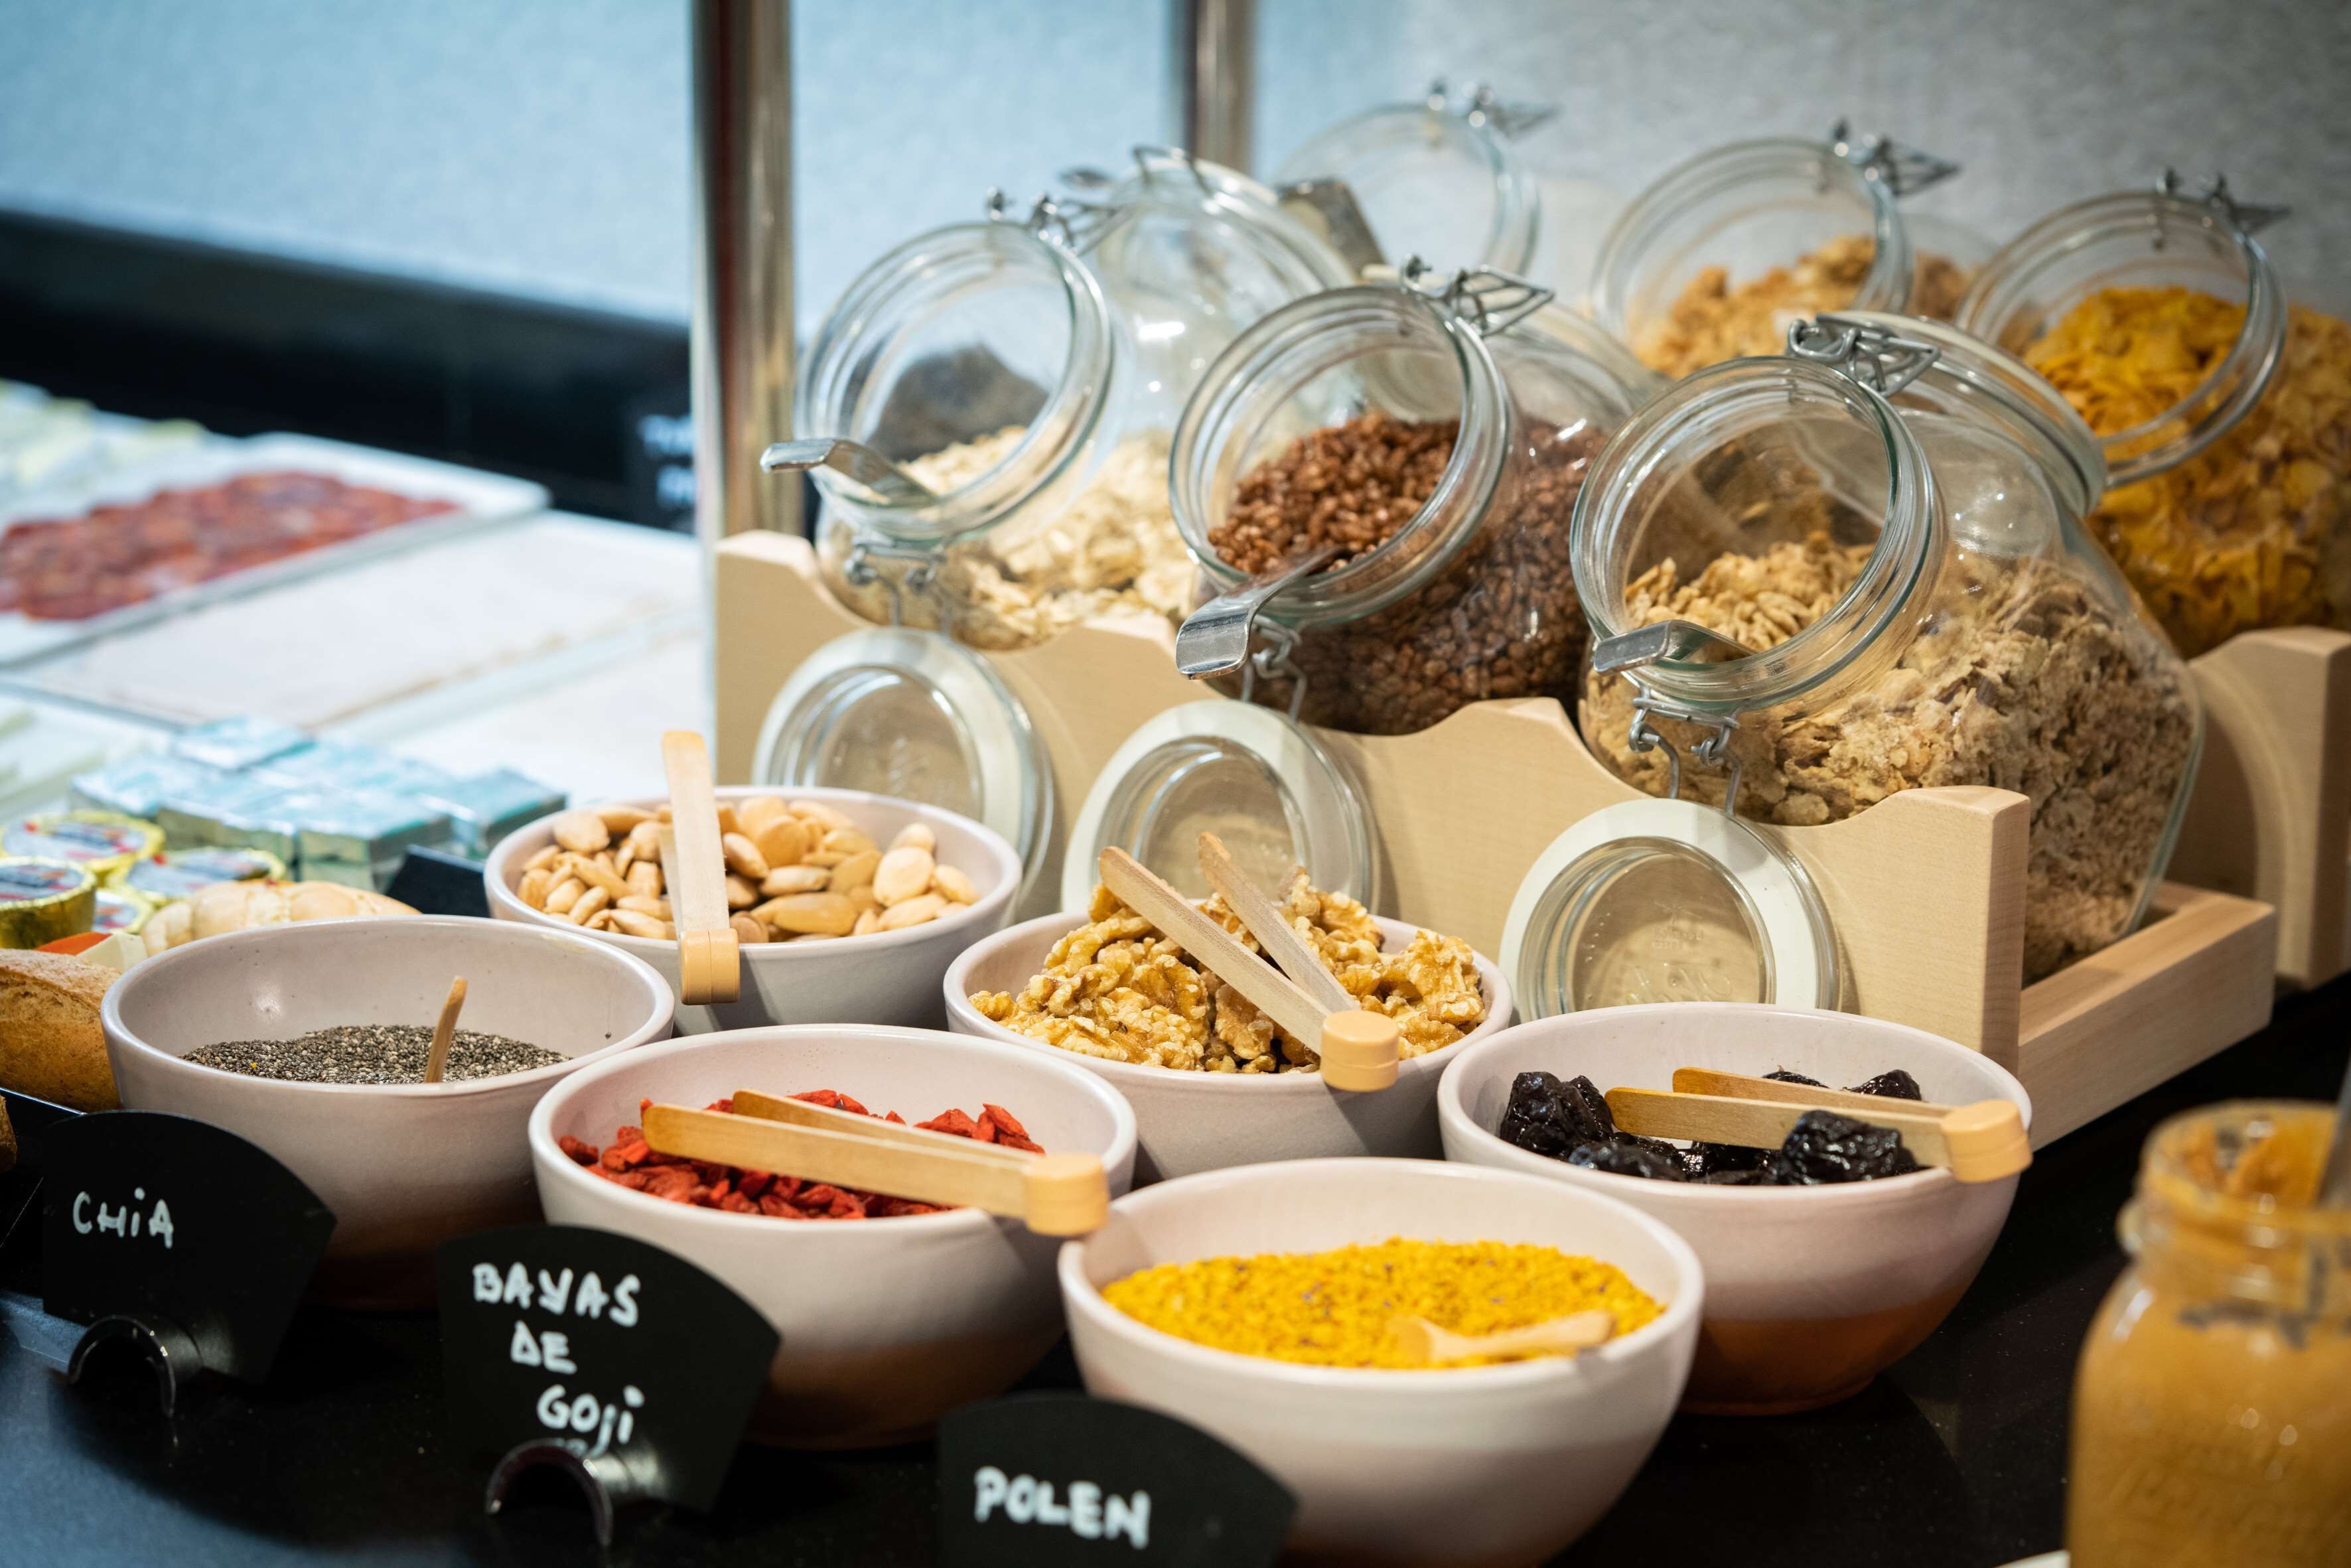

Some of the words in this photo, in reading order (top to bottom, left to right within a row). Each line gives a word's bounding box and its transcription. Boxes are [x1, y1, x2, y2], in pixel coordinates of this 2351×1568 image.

[472, 1261, 641, 1327] BAYAS
[510, 1320, 577, 1374] DE
[975, 1466, 1151, 1548] POLEN
